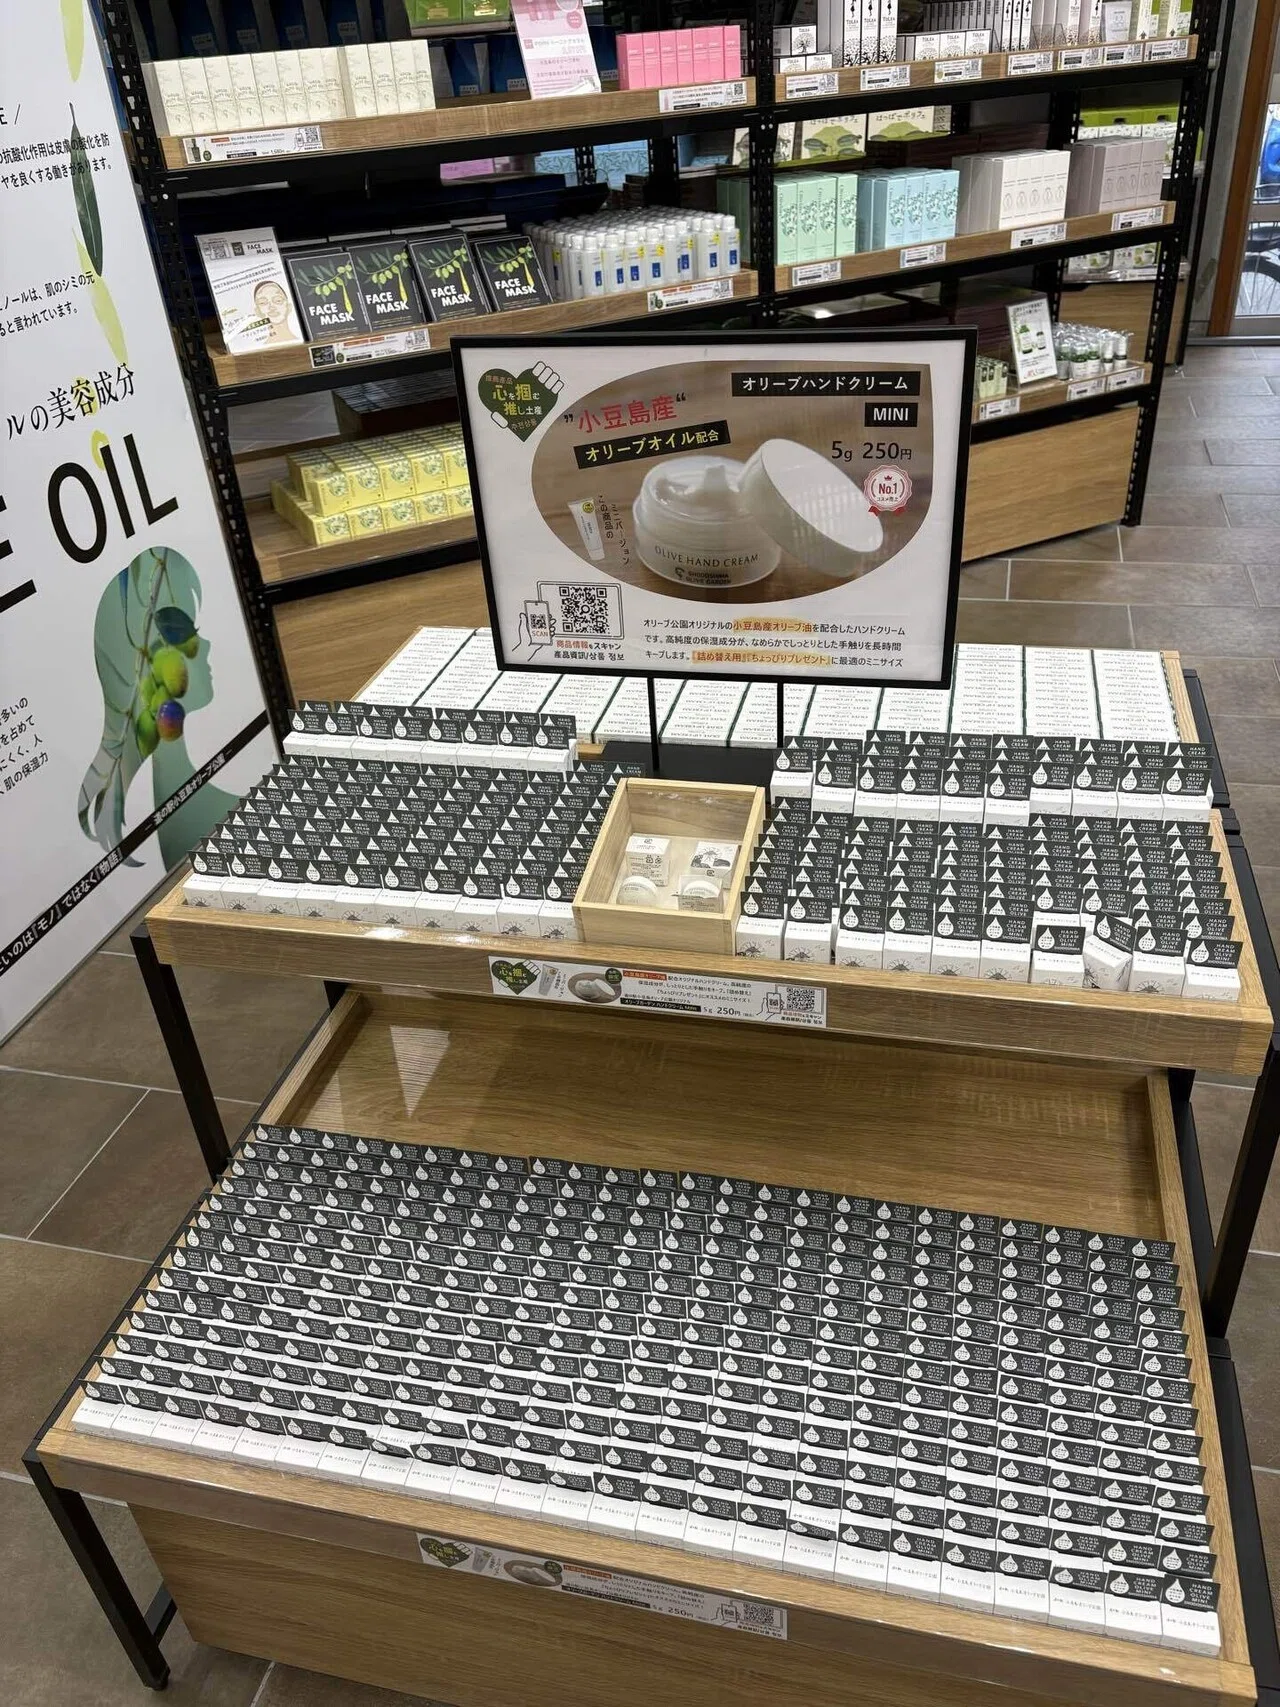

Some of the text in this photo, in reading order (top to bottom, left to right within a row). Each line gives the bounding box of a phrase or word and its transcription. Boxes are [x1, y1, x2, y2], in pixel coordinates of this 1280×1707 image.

[0, 132, 110, 165] 抗酸化作用は皮膚の酸化を防
[495, 277, 521, 290] FACE
[0, 271, 95, 311] ノールは、肌のシミの元
[430, 286, 457, 298] FACE
[505, 285, 537, 297] MASK
[365, 292, 393, 305] FACE
[442, 294, 473, 307] MASK
[309, 304, 338, 316] FACE
[376, 301, 410, 314] MASK
[320, 312, 355, 325] MASK
[742, 376, 908, 391] オリーブハンドクリーム
[7, 363, 135, 440] ルの美容成分
[503, 402, 542, 416] 推し土産
[873, 407, 909, 421] MINI
[586, 429, 720, 462] オリーブオイル配合
[831, 440, 912, 462] 5g 250円
[879, 482, 897, 494] No.1
[48, 433, 179, 563] OIL
[654, 545, 759, 568] OLIVE HAND CREAM
[0, 697, 28, 725] 多いの
[717, 1006, 741, 1017] 250円
